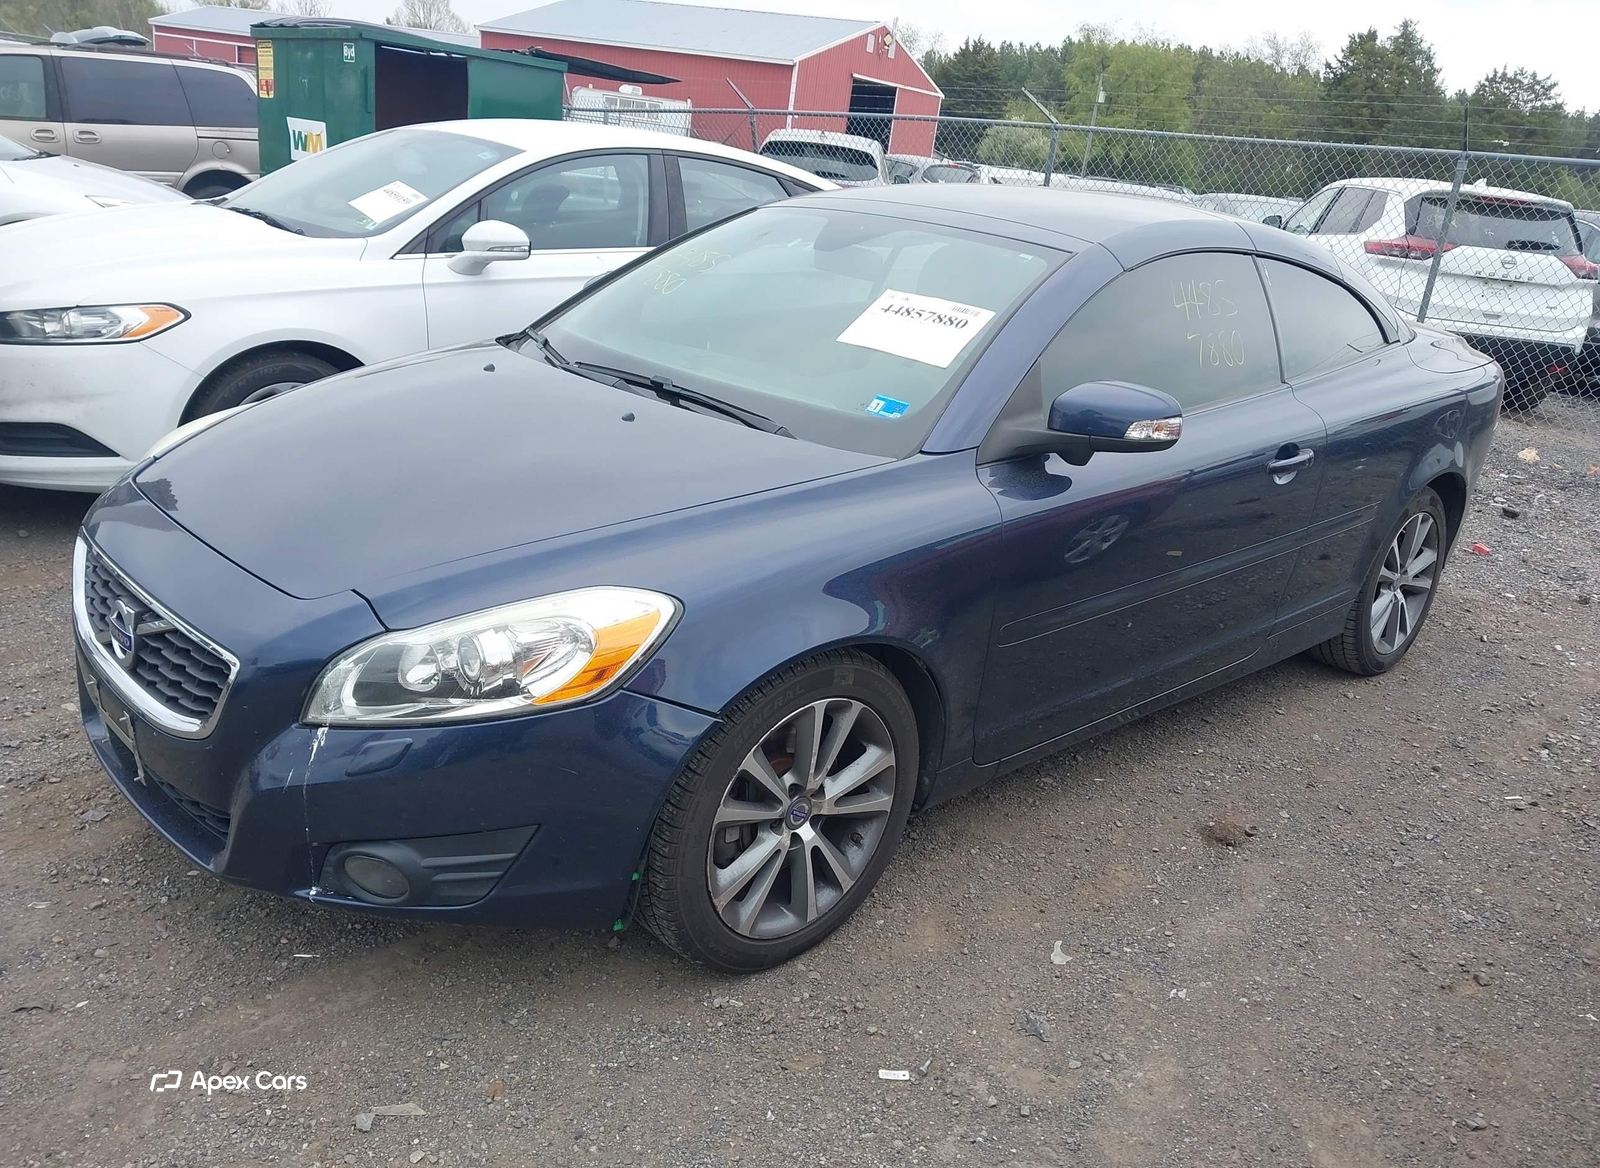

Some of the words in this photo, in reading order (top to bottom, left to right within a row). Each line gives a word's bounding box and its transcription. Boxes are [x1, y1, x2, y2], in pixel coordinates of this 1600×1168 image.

[292, 129, 323, 153] WM
[1474, 269, 1535, 282] ROGUE
[1170, 279, 1238, 321] 4485
[881, 303, 969, 330] 44857880
[1186, 329, 1245, 369] 7880
